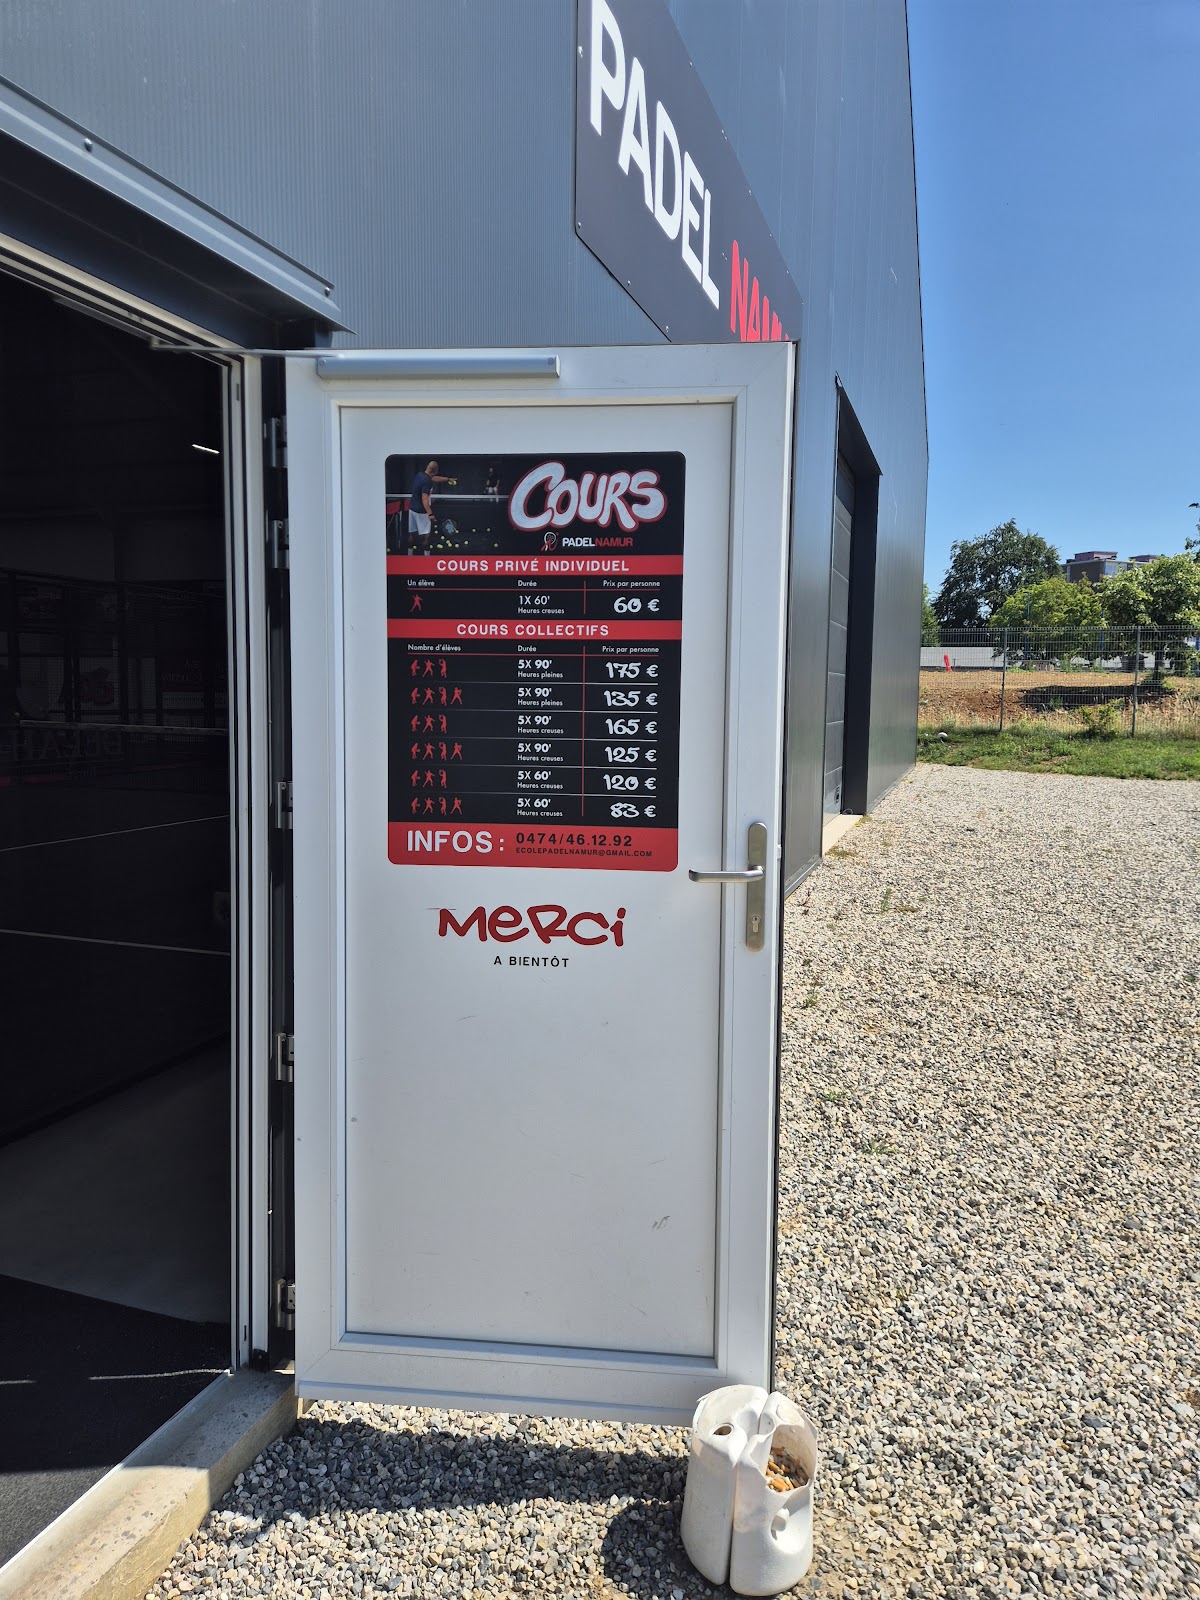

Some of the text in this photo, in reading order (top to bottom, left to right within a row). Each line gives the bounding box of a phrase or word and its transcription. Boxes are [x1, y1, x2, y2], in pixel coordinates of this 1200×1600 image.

[590, 0, 720, 310] PADEL
[508, 460, 667, 533] COURS
[437, 558, 630, 572] COURS PRIVÉ INDIVIDUEL
[417, 579, 435, 587] élève
[617, 581, 629, 589] par
[630, 581, 661, 589] personne
[518, 595, 551, 605] 1X 60'
[613, 597, 660, 613] 60 €
[457, 624, 609, 636] COURS COLLECTIFS
[518, 659, 552, 670] 5X 90'
[605, 662, 659, 678] 175 €
[540, 671, 564, 680] pleines
[517, 687, 552, 698] 5X 90'
[604, 690, 658, 707] 135 €
[540, 699, 564, 708] pleines
[517, 715, 552, 725] 5X 90'
[605, 718, 658, 735] 165 €
[517, 743, 552, 753] 5X 90'
[517, 754, 539, 762] Heures
[604, 746, 657, 763] 125 €
[517, 771, 552, 781] 5X 60'
[603, 774, 657, 791] 120 €
[517, 798, 552, 808] 5X 60'
[610, 803, 656, 818] 83 €
[407, 830, 493, 853] INFOS
[516, 832, 632, 847] 0474/46.12.92
[515, 847, 653, 857] ECOLEPADELNAMUR@GMAIL.COM
[493, 955, 569, 968] A BIENTÔT
